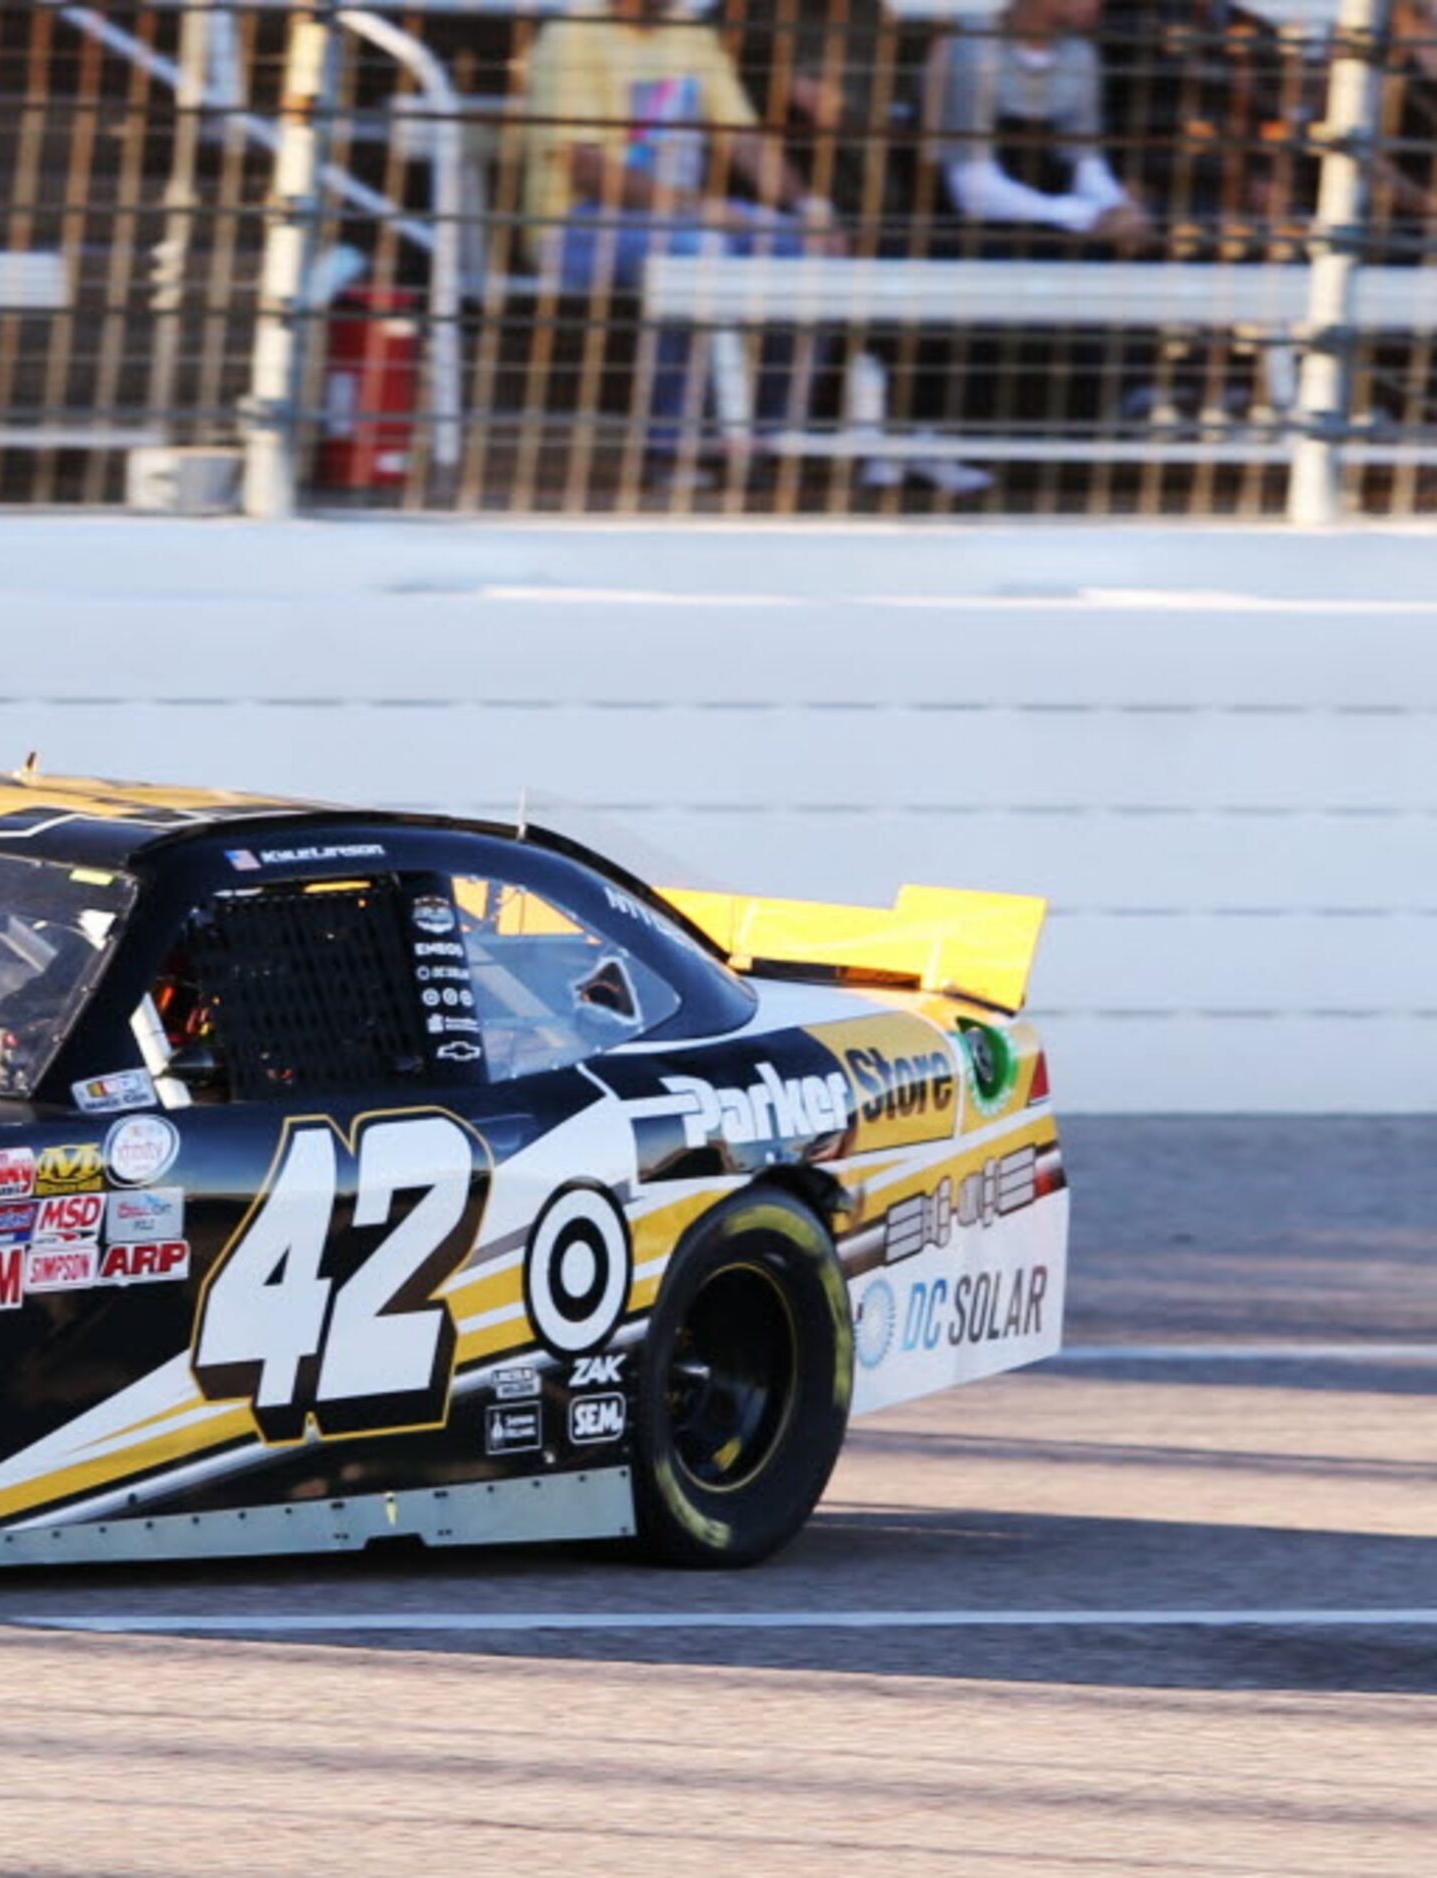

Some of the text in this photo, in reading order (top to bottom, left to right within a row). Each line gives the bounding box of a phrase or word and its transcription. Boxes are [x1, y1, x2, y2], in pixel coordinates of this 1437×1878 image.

[660, 1046, 953, 1149] Parker Store
[39, 1196, 102, 1231] MSD
[103, 1243, 187, 1277] ARP
[196, 1116, 473, 1408] 42
[901, 1265, 1049, 1351] DC SOLAR
[568, 1353, 627, 1387] ZAK
